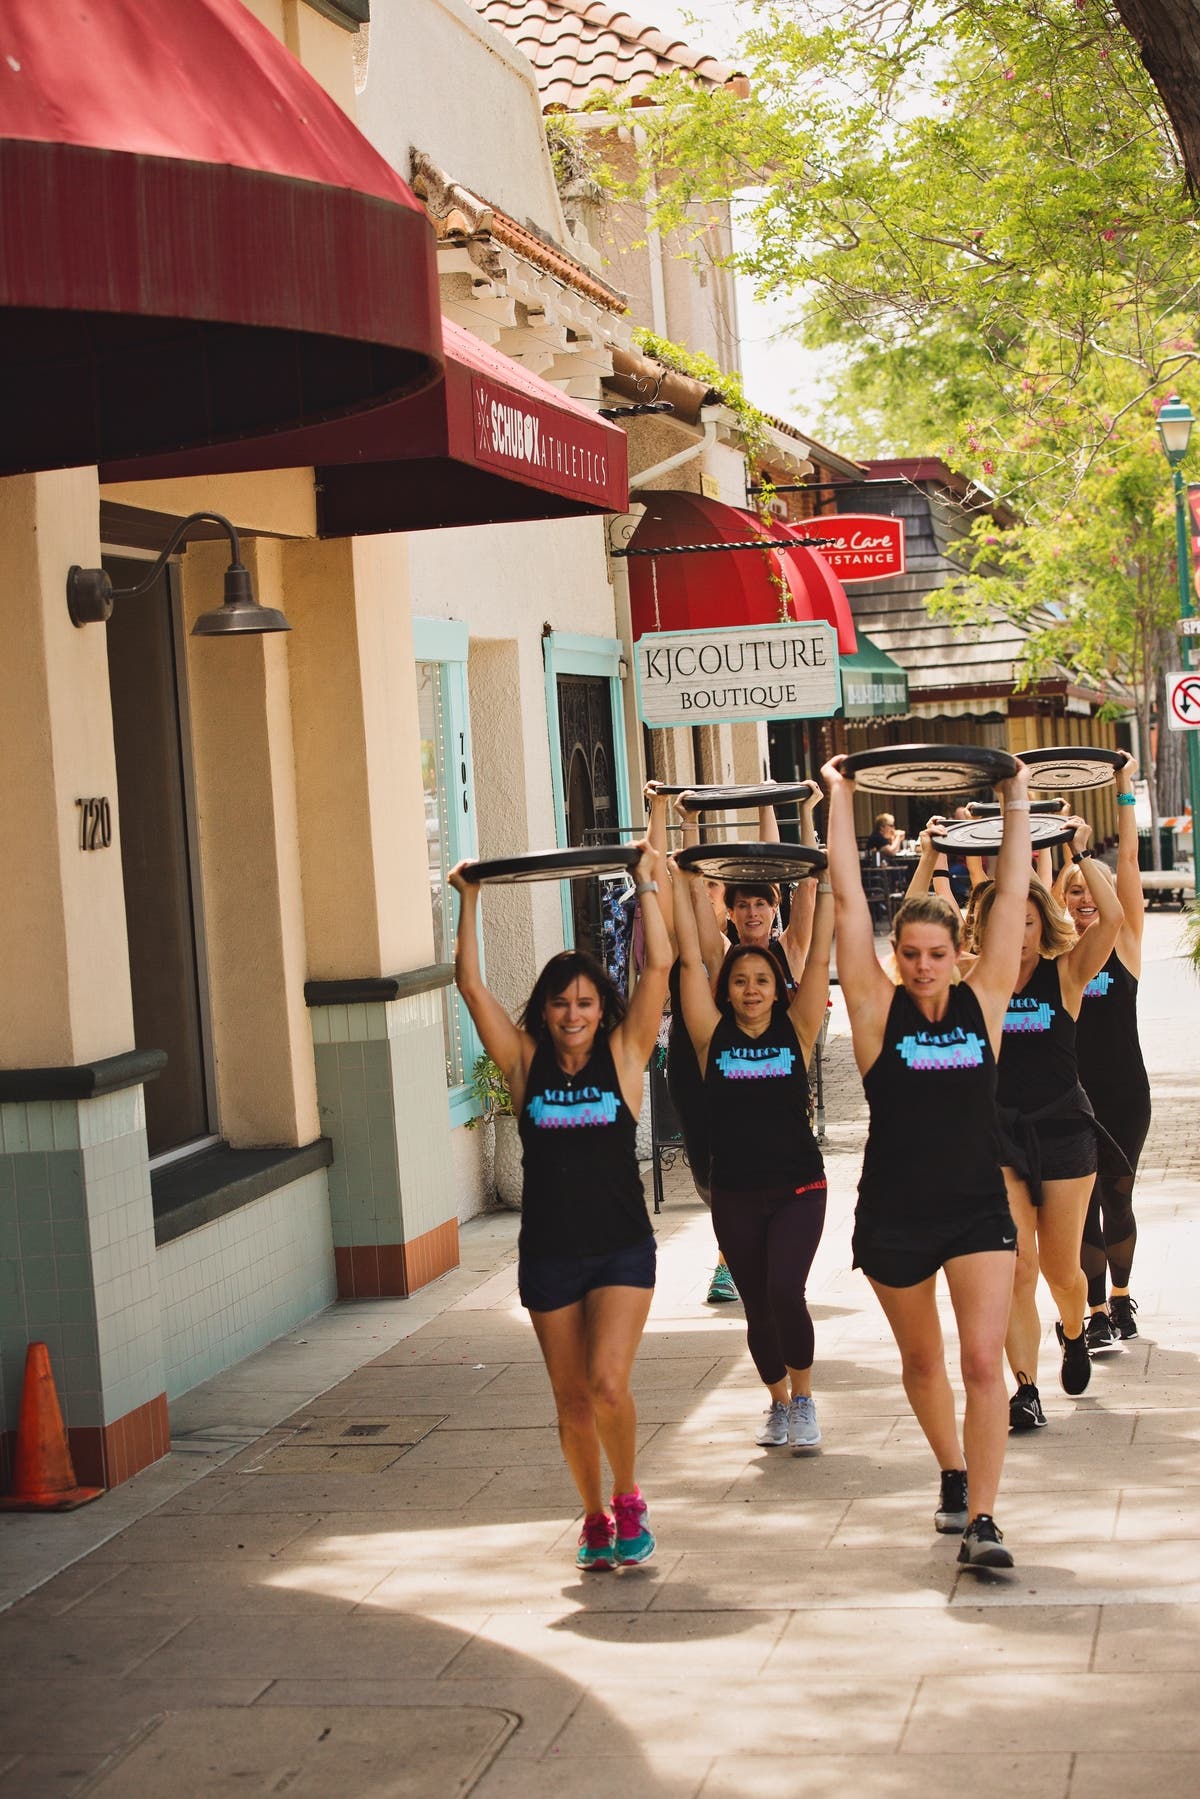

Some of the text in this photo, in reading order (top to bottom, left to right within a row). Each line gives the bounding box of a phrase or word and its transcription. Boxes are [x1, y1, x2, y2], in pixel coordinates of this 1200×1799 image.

[541, 434, 606, 486] ATHLETICS
[825, 553, 894, 565] ISTANCE
[850, 531, 893, 550] Care
[645, 637, 827, 685] KJCOUTURE
[680, 684, 798, 709] BOUTIQUE
[459, 732, 469, 814] 706
[75, 796, 112, 852] 720
